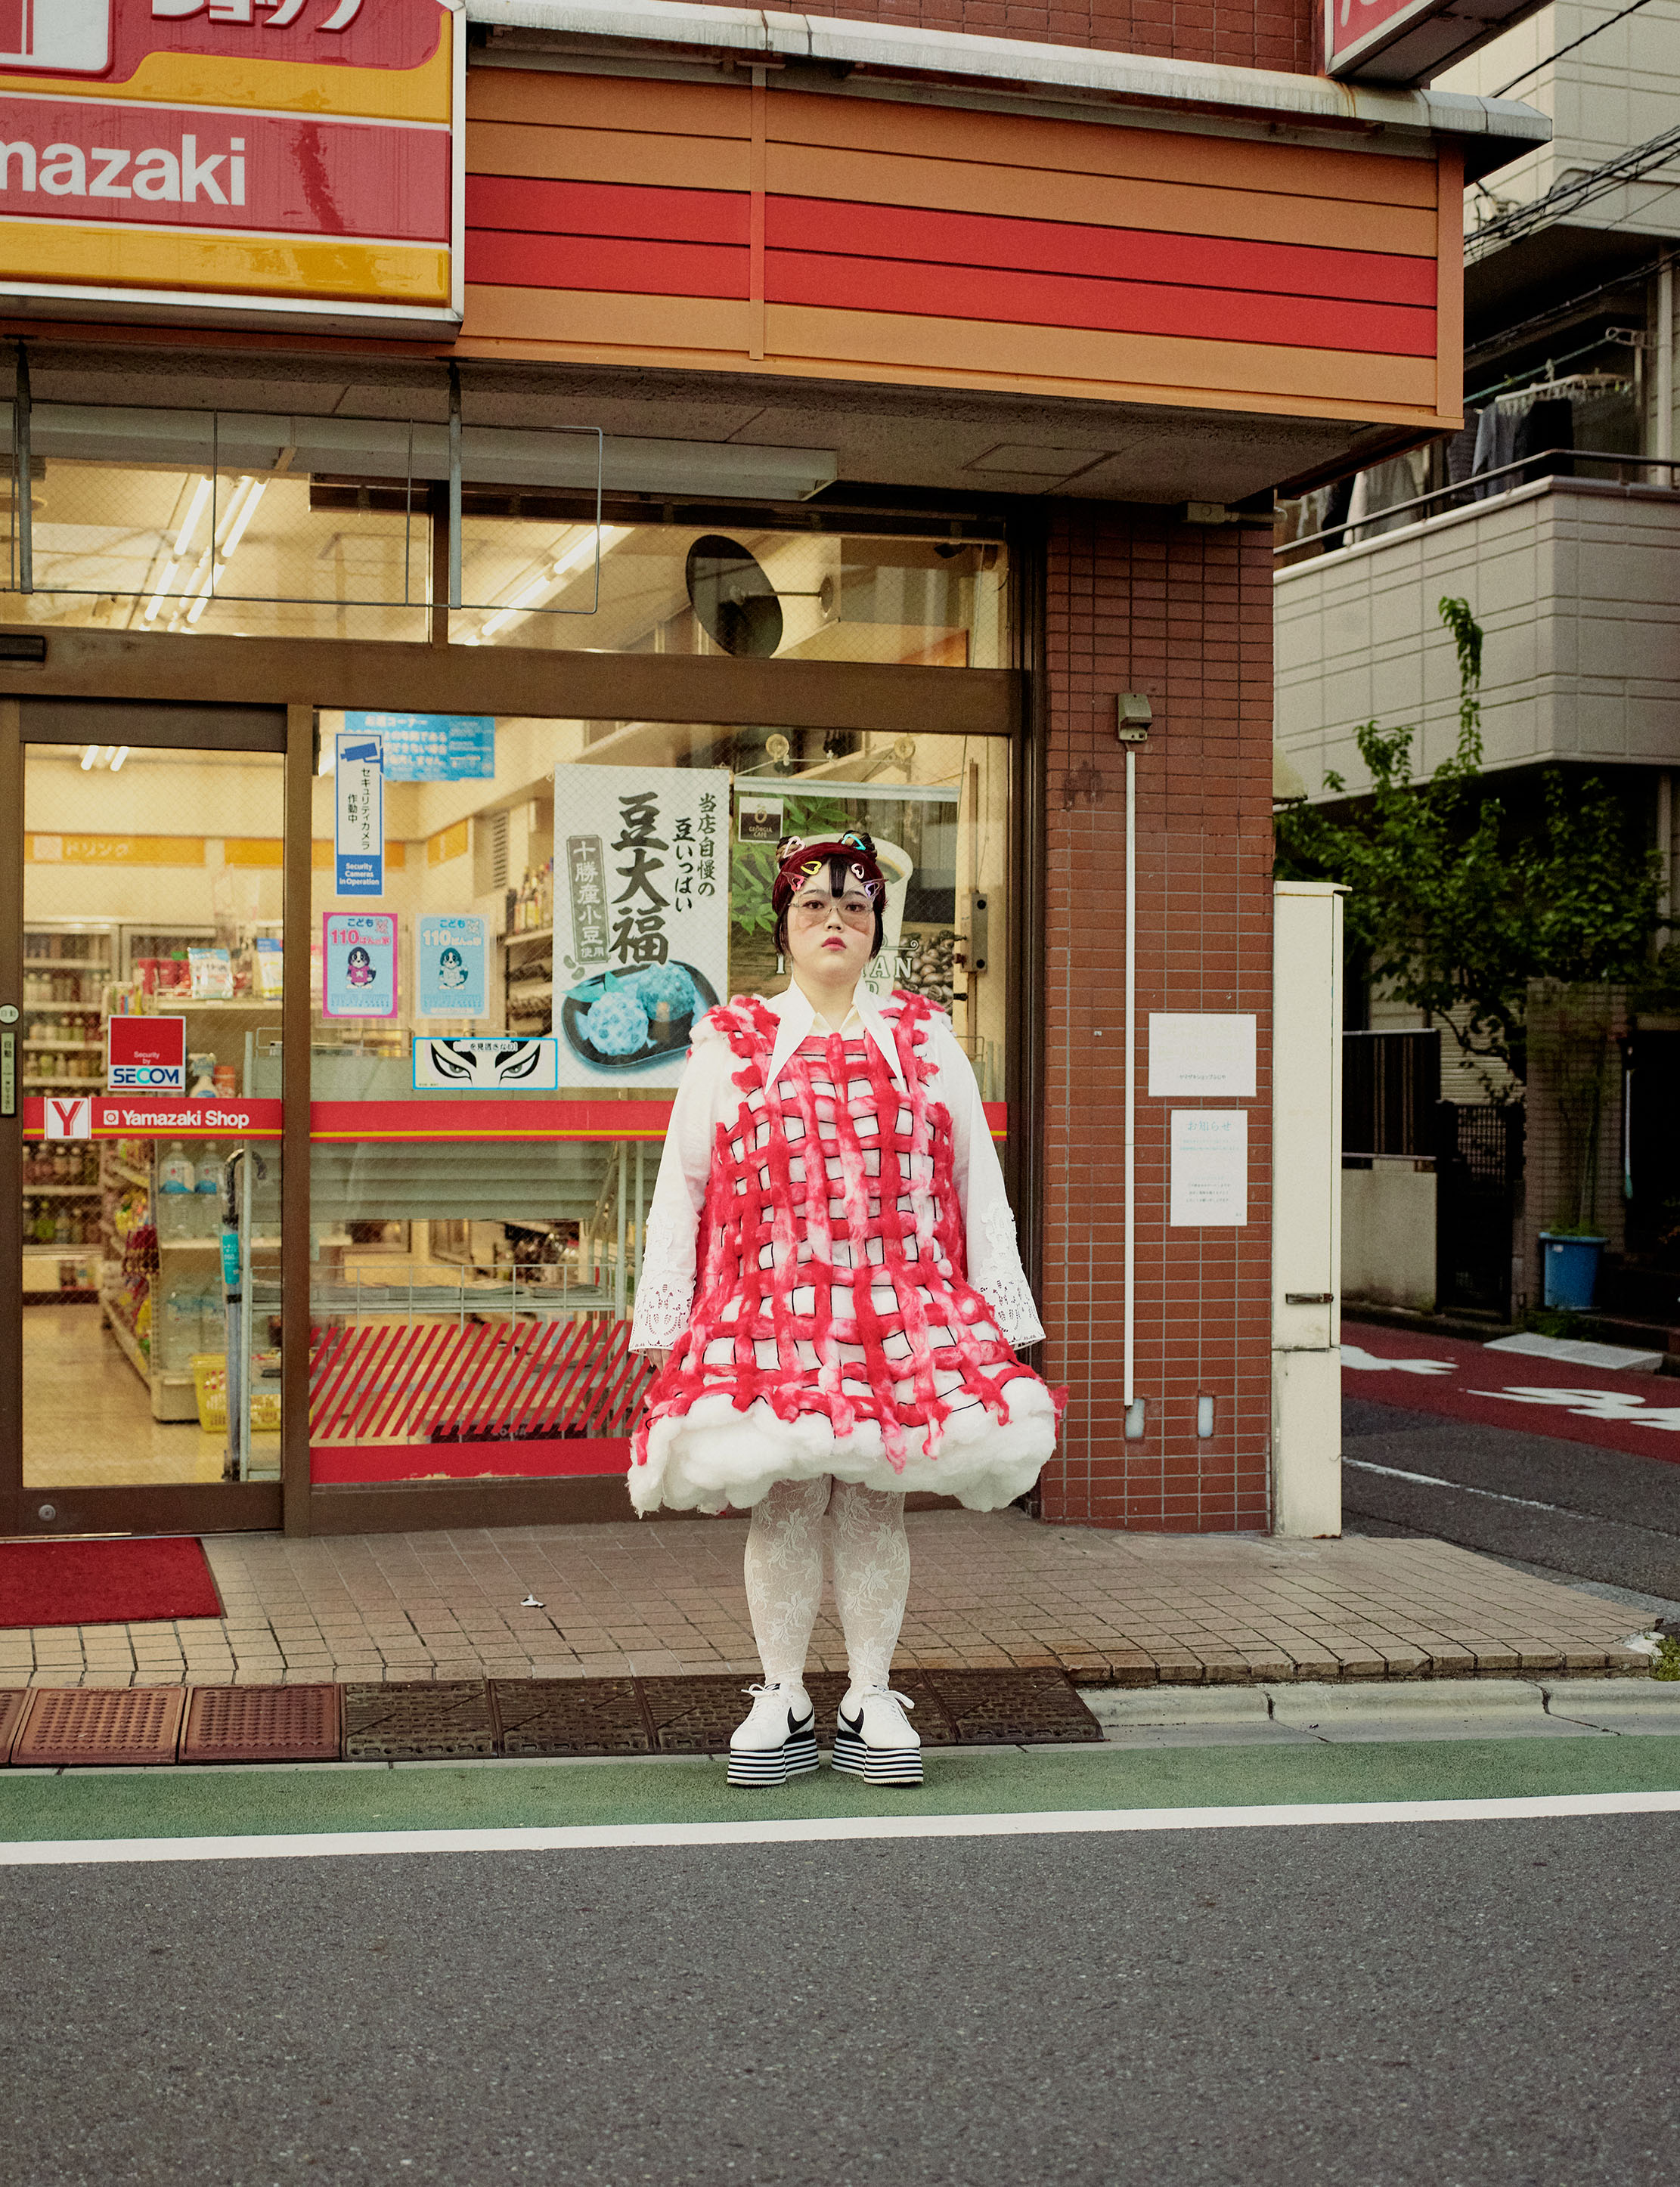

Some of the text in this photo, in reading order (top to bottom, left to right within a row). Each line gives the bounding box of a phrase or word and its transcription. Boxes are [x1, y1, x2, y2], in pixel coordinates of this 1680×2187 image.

[348, 795, 358, 823] 作動中
[361, 768, 370, 850] セキュリティカメラ
[697, 793, 717, 896] 当店自慢の
[346, 863, 373, 871] Security
[346, 878, 380, 887] Operation
[608, 791, 670, 965] 豆大福
[347, 918, 374, 928] こども
[440, 919, 466, 928] こども
[134, 1051, 160, 1059] Security
[113, 1067, 179, 1084] SECOM
[122, 1110, 250, 1129] Yamazaki Shop
[1187, 1120, 1232, 1132] お知らせ
